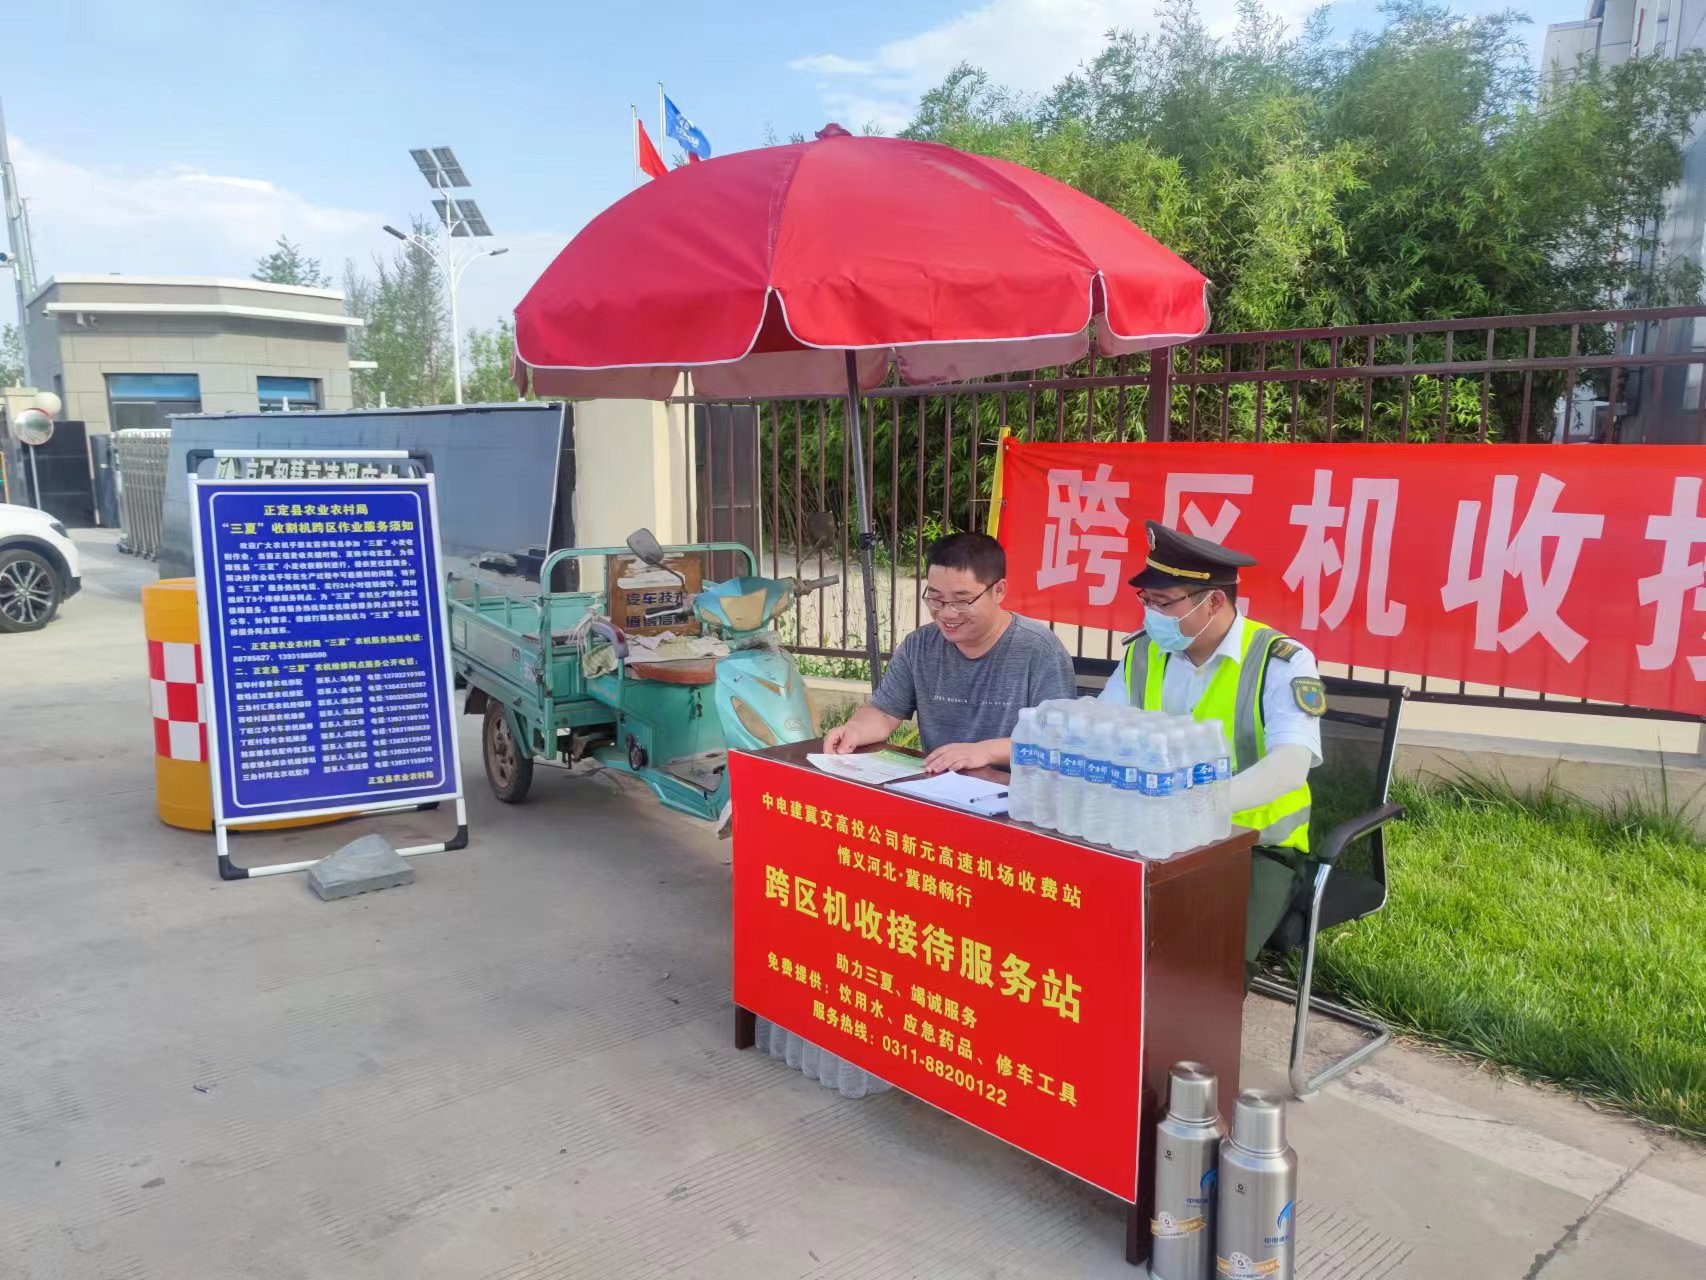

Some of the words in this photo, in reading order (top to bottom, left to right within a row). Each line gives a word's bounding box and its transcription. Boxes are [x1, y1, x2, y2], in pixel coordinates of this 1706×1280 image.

[762, 791, 1082, 909] 中电建冀交高投公司新元高速机场收费站
[764, 864, 1082, 1024] 跨区机收接待服务站
